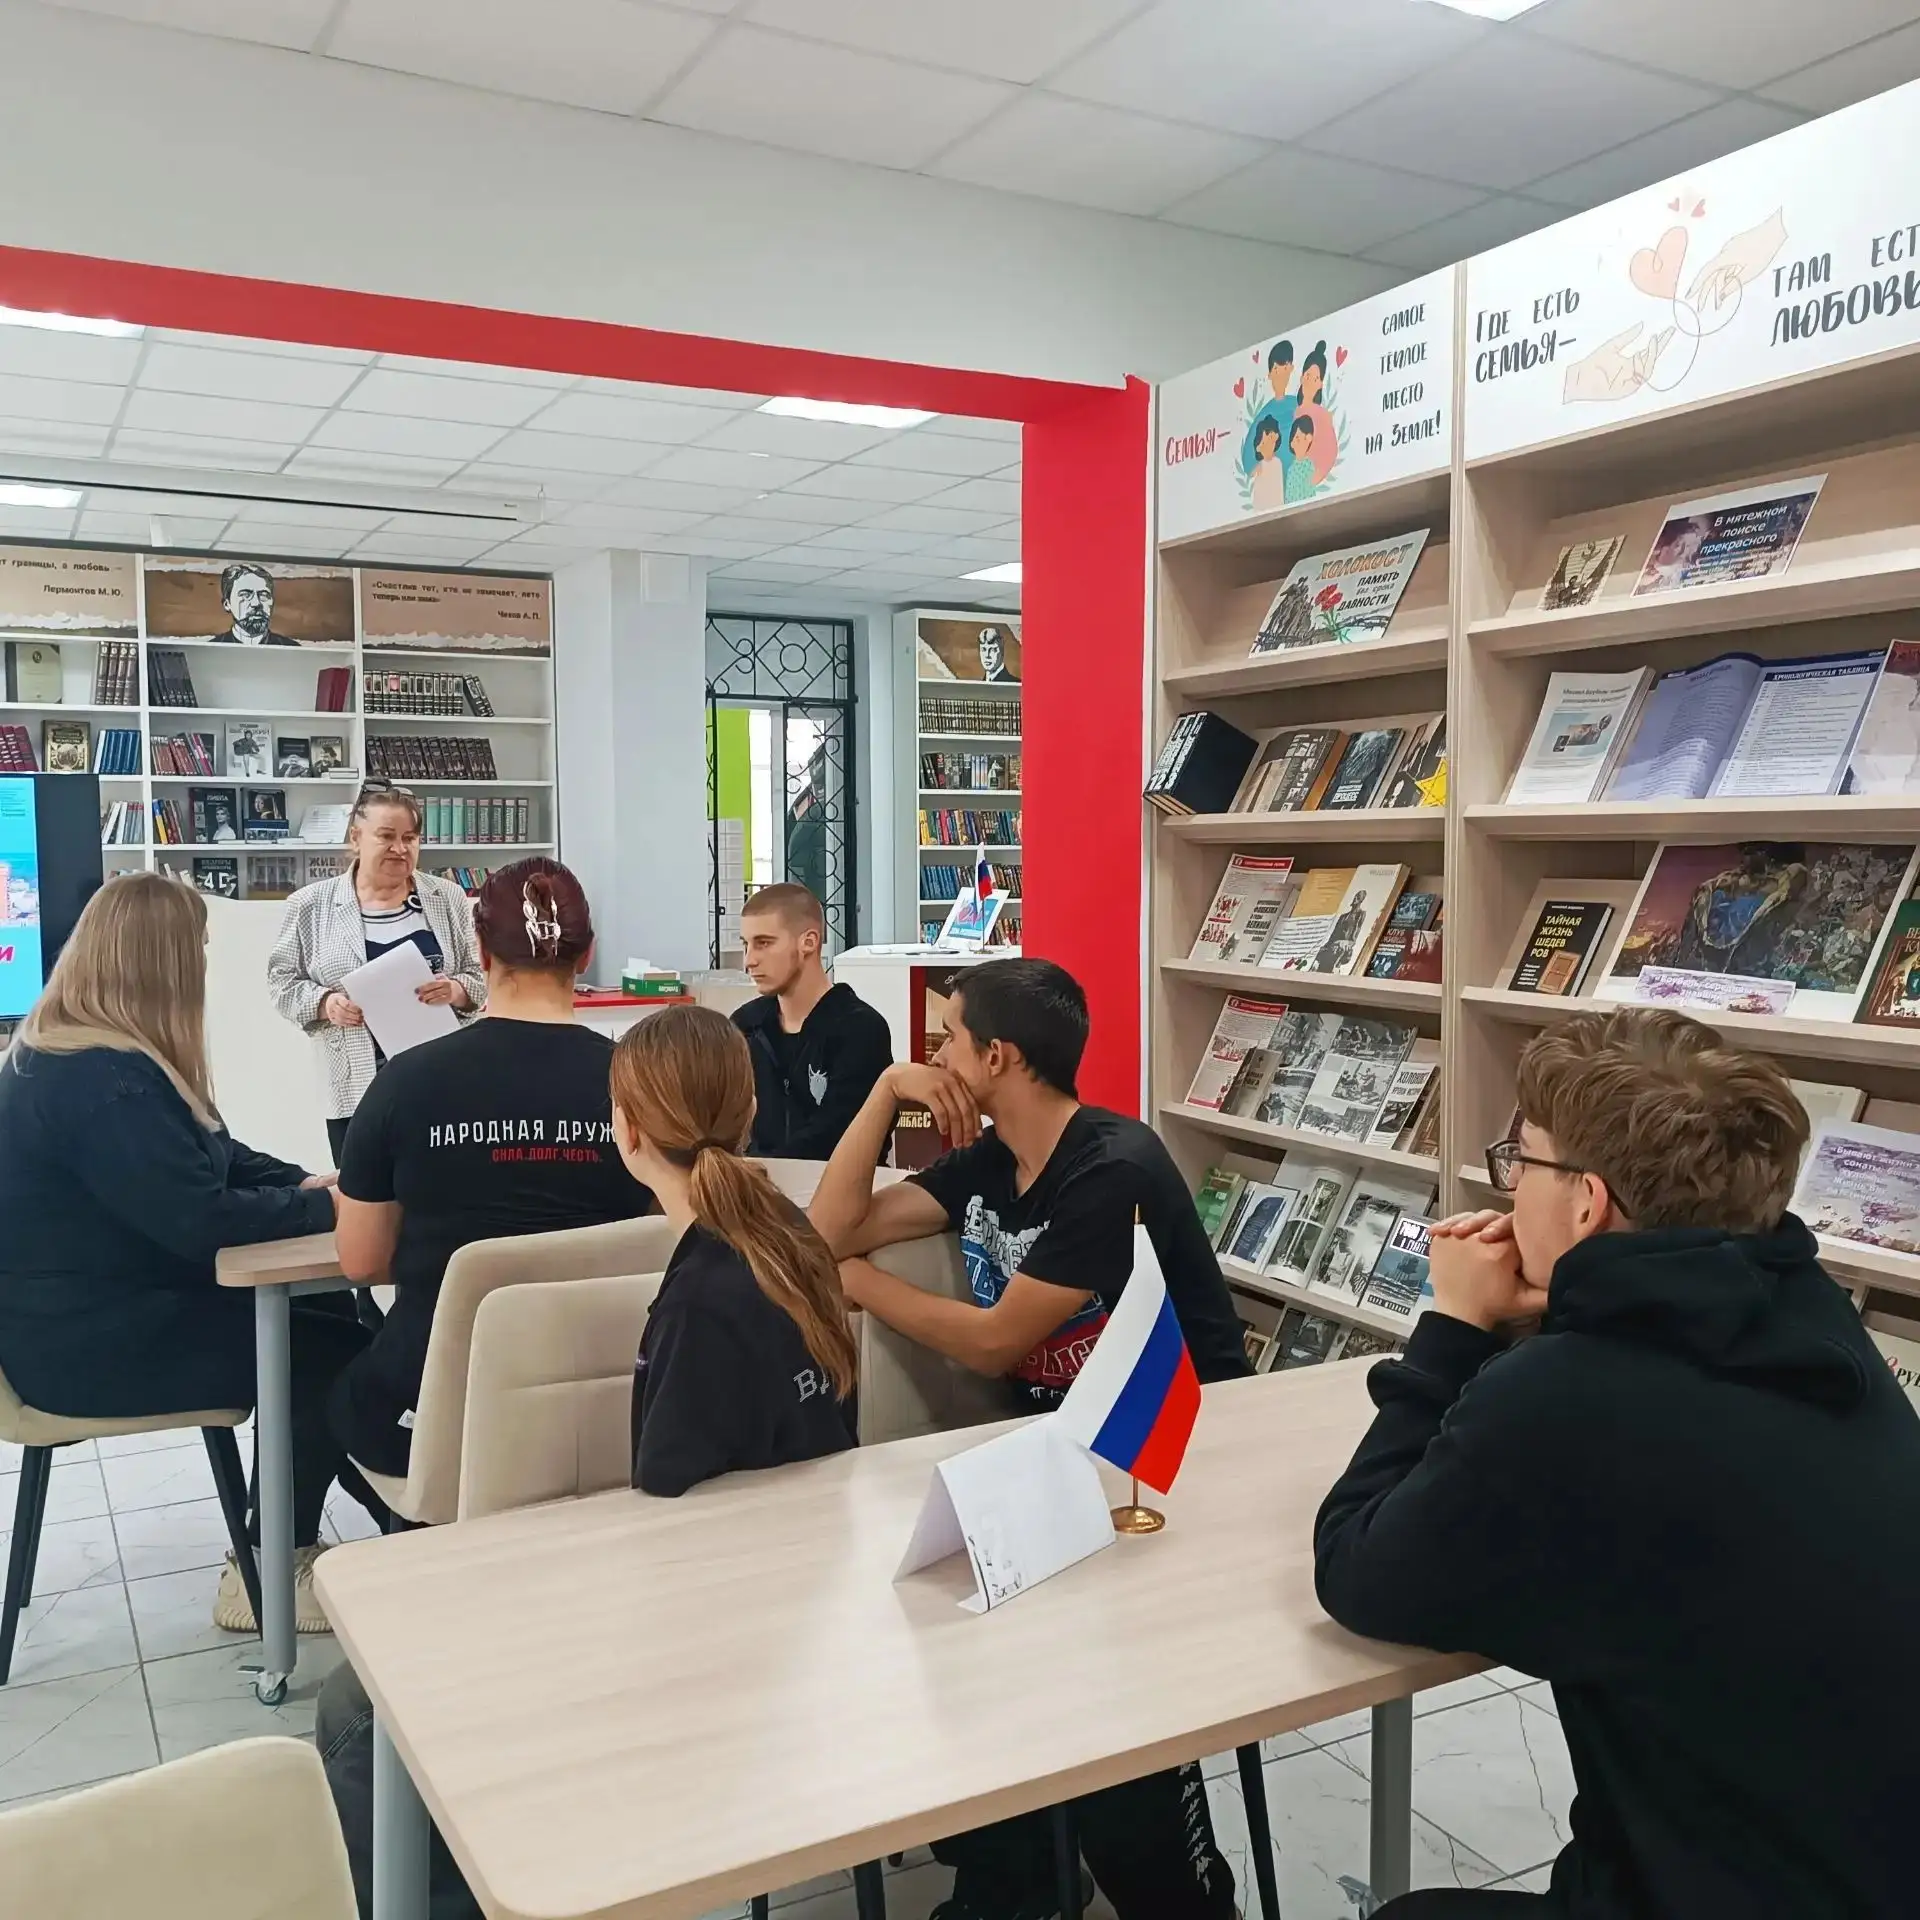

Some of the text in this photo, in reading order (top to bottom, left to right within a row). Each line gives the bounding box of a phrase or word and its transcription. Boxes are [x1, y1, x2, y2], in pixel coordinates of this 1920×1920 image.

[1773, 252, 1831, 299] ТАМ
[1382, 303, 1427, 336] САМОЕ
[1476, 287, 1580, 343] ГДЕ ЕСТЬ
[1380, 341, 1428, 375] ТЁПЛОЕ
[1382, 382, 1424, 413] МЕСТО
[1365, 409, 1441, 455] НА ЗЕМЛЕ!
[1714, 505, 1788, 527] В мятежном
[1722, 522, 1766, 538] поиске
[1699, 533, 1778, 555] прекрасного
[73, 563, 110, 571] любовь
[1316, 543, 1415, 581] ХОЛОКОСТ
[1357, 571, 1400, 586] ПАМЯТЬ
[43, 585, 96, 595] Лермонтов
[1337, 593, 1390, 611] ДАВНОСТИ
[1545, 914, 1582, 926] ТАЙНАЯ
[1535, 938, 1566, 948] ШЕДЕВ
[1540, 927, 1573, 937] ЖИЗНЬ
[1530, 948, 1549, 958] РОВ
[430, 1119, 544, 1147] НАРОДНАЯ
